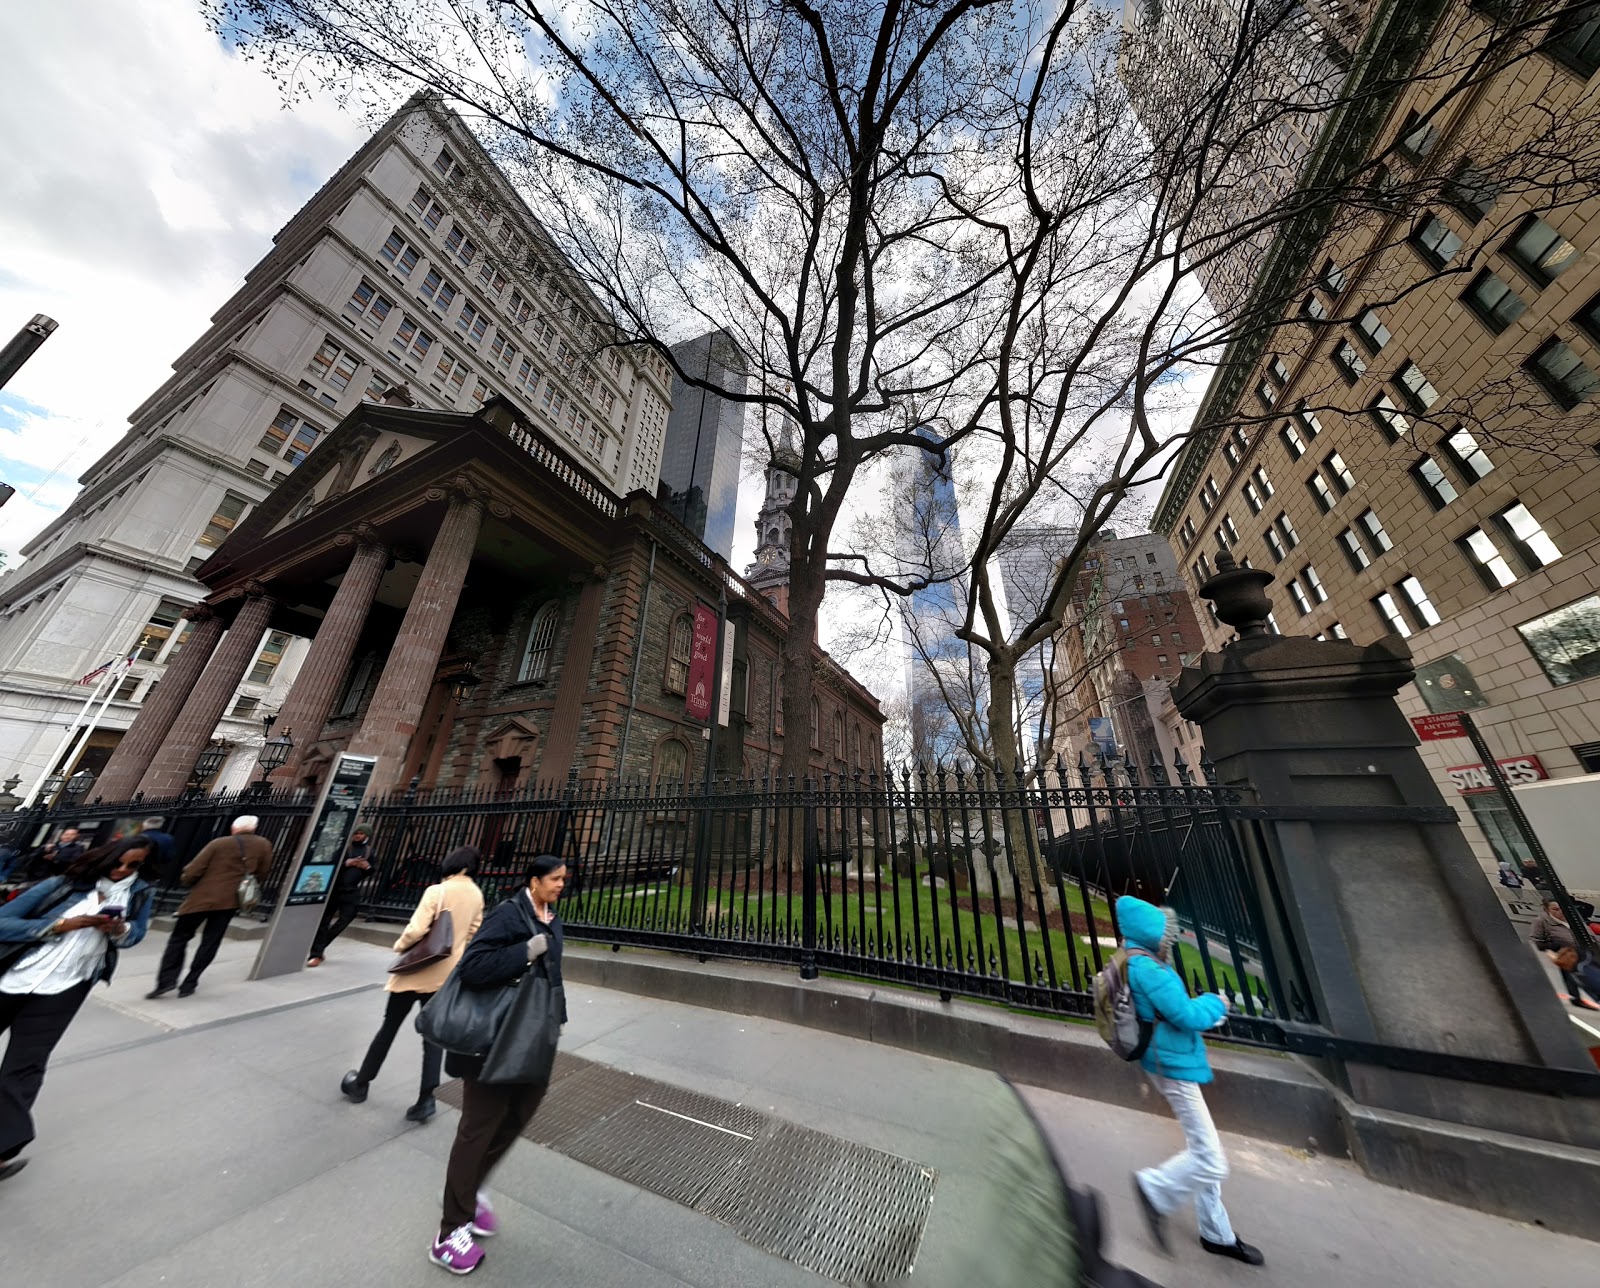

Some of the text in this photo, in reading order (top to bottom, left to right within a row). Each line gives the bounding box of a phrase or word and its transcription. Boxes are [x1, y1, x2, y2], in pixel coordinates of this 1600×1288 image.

[696, 612, 705, 622] for
[696, 632, 712, 645] world
[695, 641, 703, 651] of
[694, 651, 708, 662] good
[690, 693, 709, 710] Trinity
[1426, 713, 1460, 723] STANDIN
[1424, 720, 1462, 730] ANYTIME
